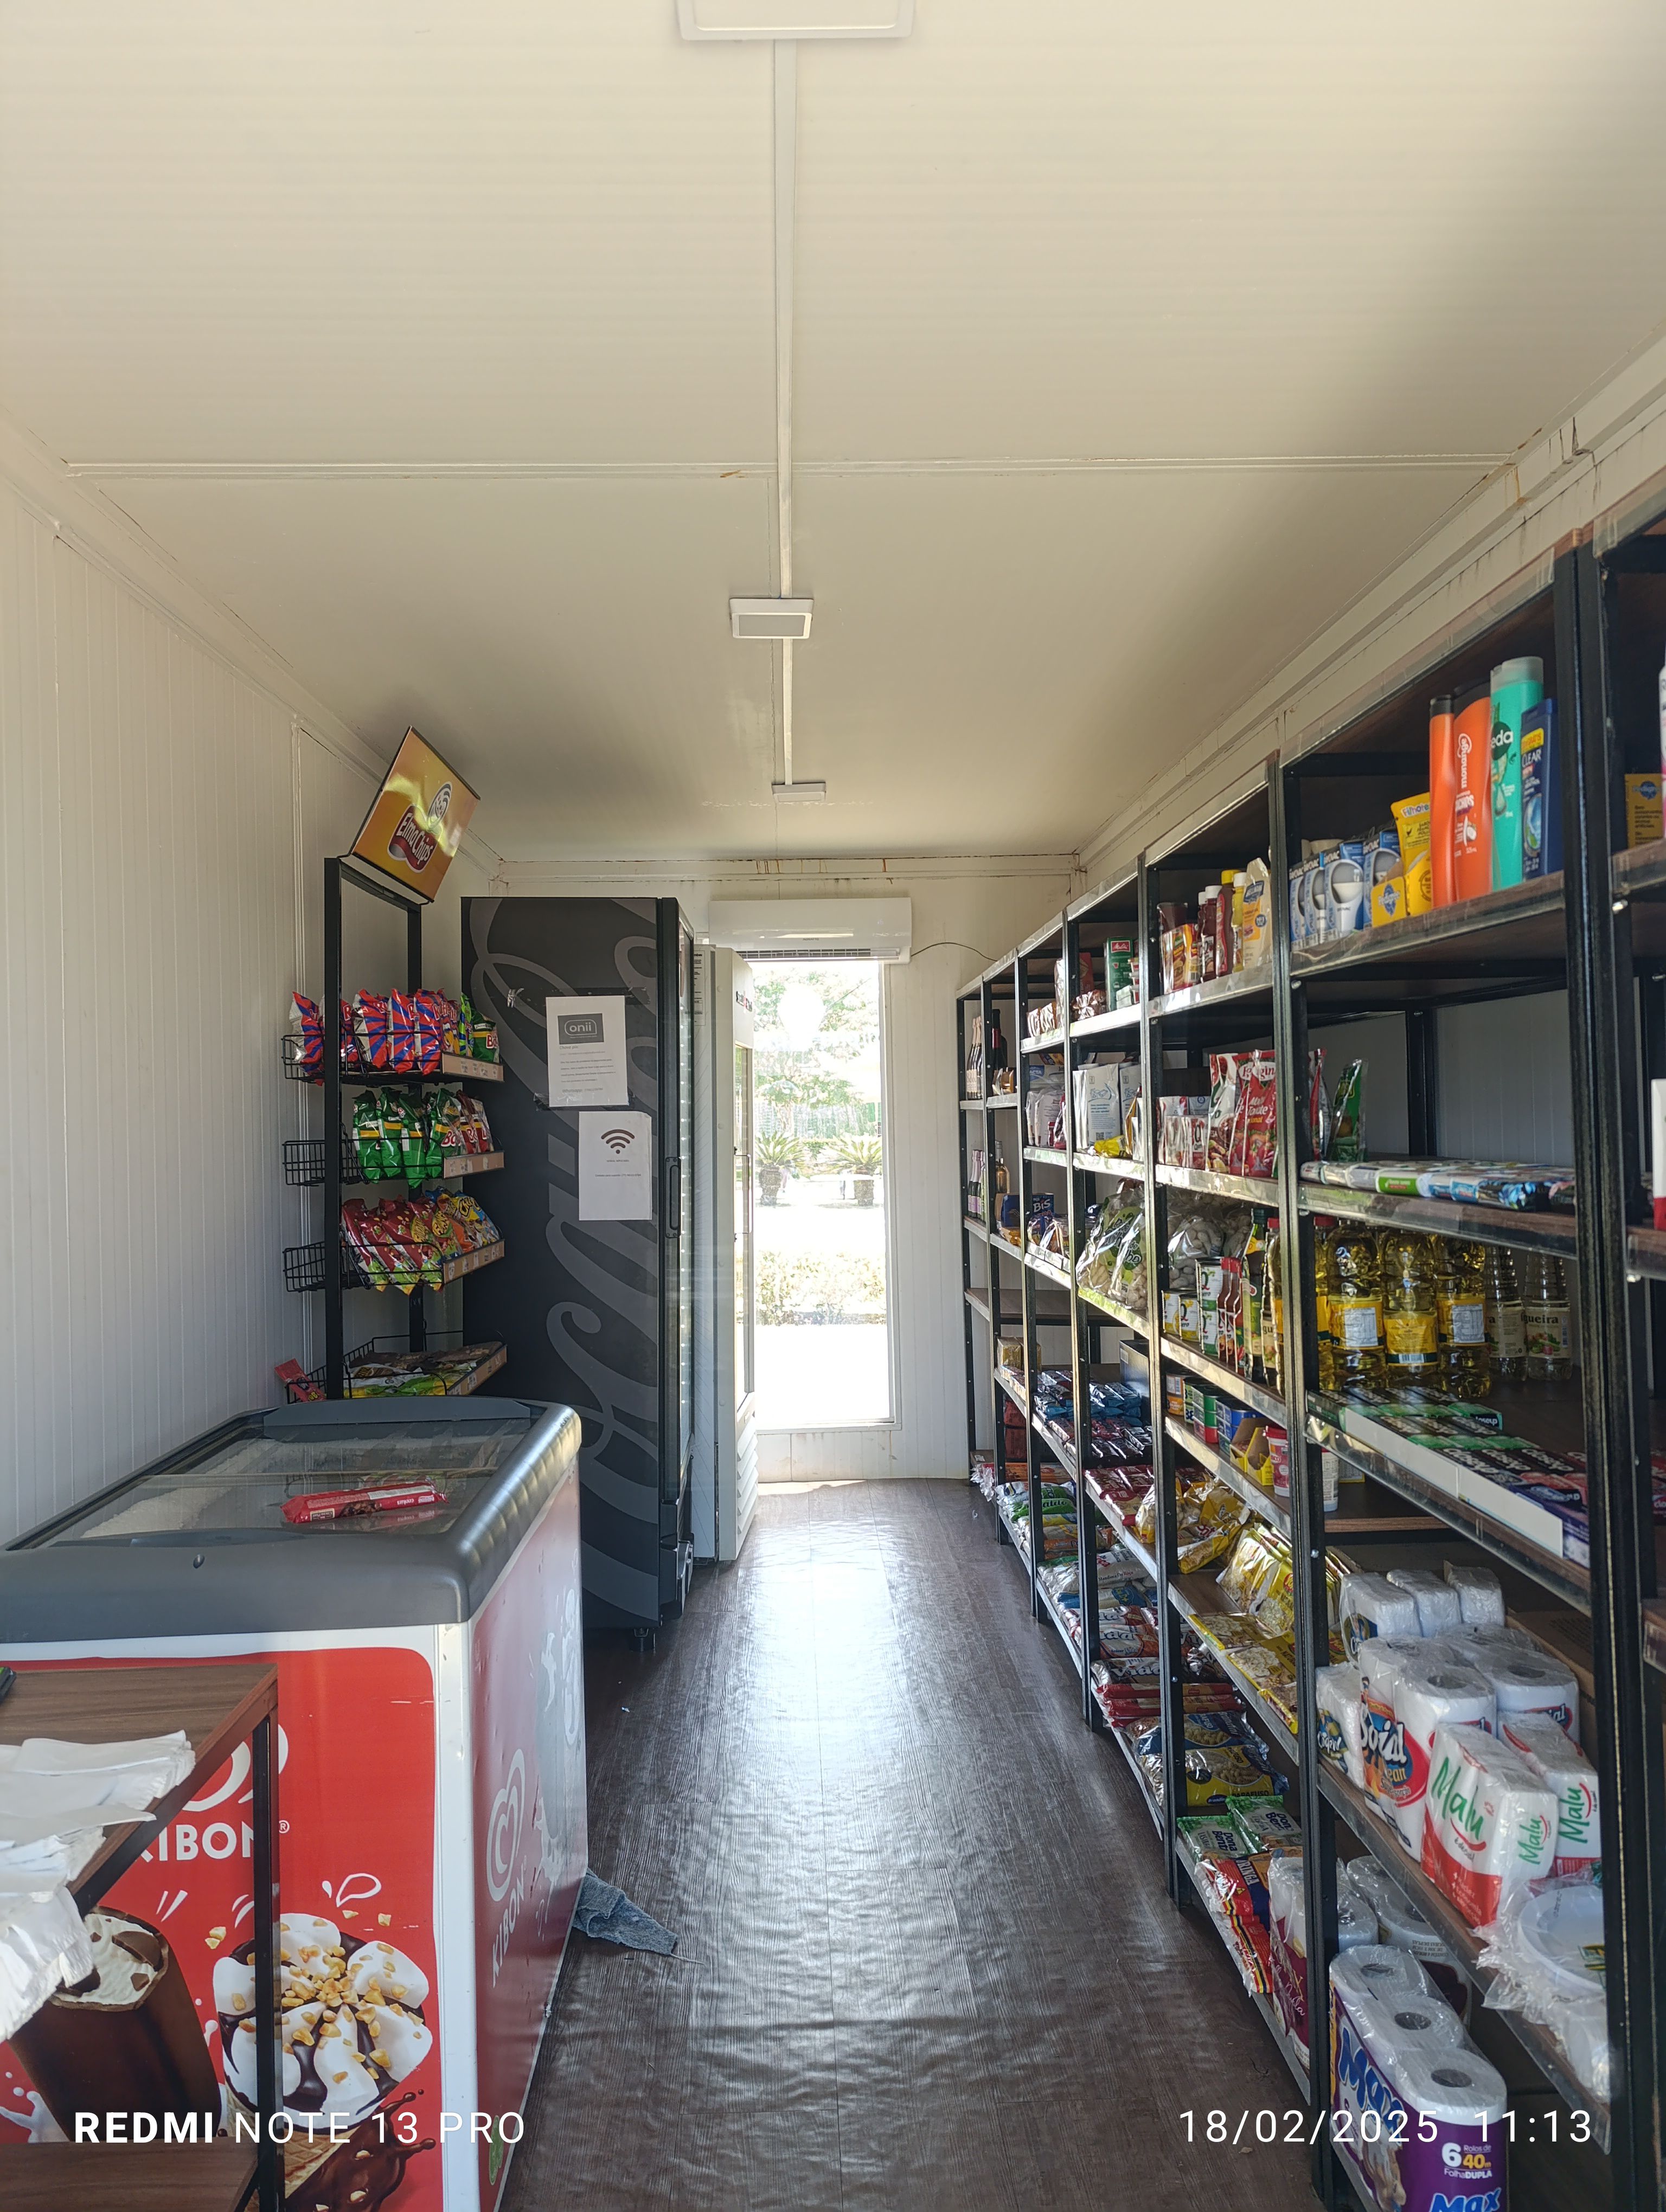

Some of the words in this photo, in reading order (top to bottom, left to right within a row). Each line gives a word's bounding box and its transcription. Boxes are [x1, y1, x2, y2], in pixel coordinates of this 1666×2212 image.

[1491, 730, 1514, 749] eda
[1461, 737, 1469, 789] monange
[1522, 749, 1542, 768] CLEAR
[1401, 803, 1430, 816] Filhote
[569, 1022, 592, 1032] onii
[1043, 1500, 1067, 1508] aldo
[1099, 1611, 1120, 1621] da
[1100, 1630, 1135, 1641] ida
[1431, 1756, 1485, 1841] Malu
[1558, 1787, 1590, 1844] Malu
[141, 1821, 254, 1863] IBO
[1517, 1817, 1543, 1865] Malu
[492, 1876, 524, 1988] KIBON
[1442, 2142, 1462, 2168] 6
[1429, 2187, 1502, 2212] Max
